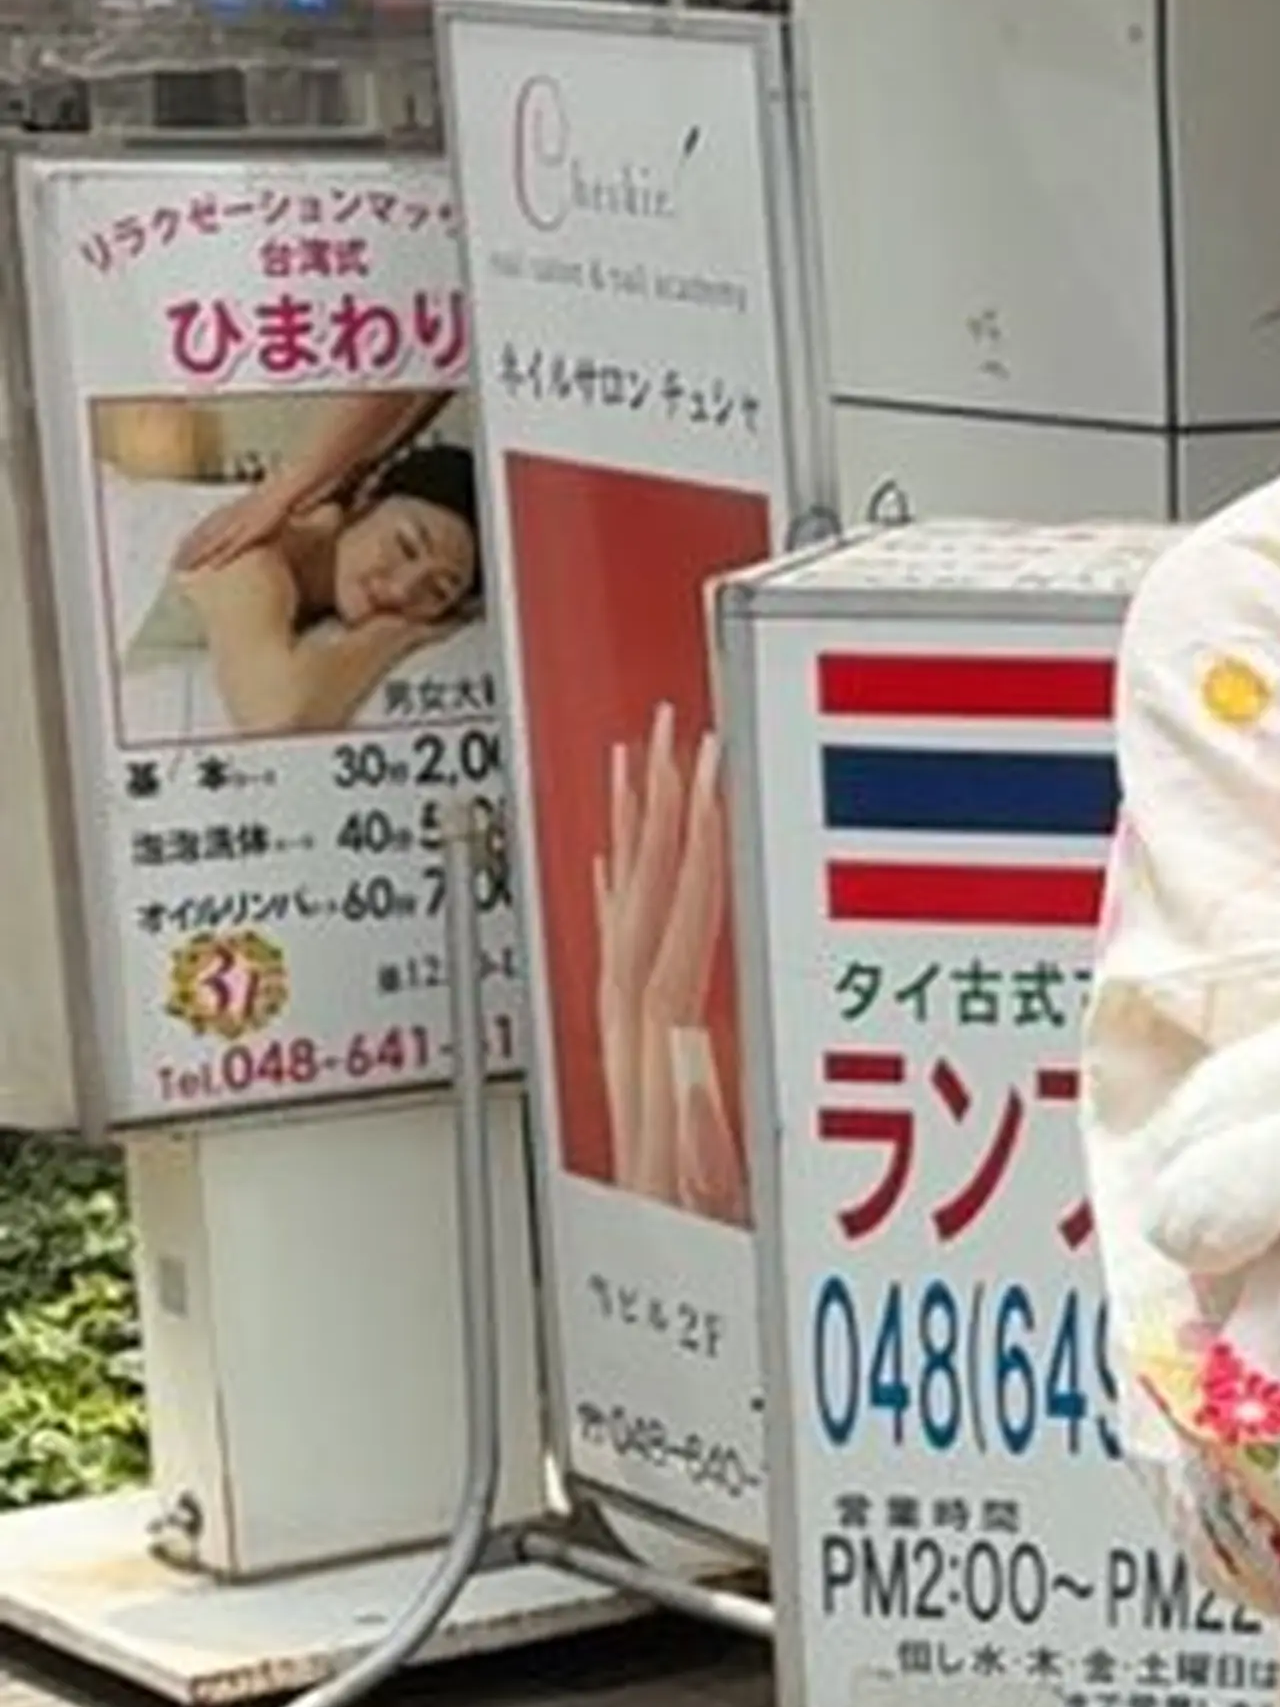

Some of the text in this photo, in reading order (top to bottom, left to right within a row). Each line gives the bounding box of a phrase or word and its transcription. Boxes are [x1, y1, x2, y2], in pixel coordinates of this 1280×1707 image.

[260, 239, 369, 279] 台湾式
[166, 290, 468, 375] ひまわり
[835, 1495, 1021, 1535] 営業時間
